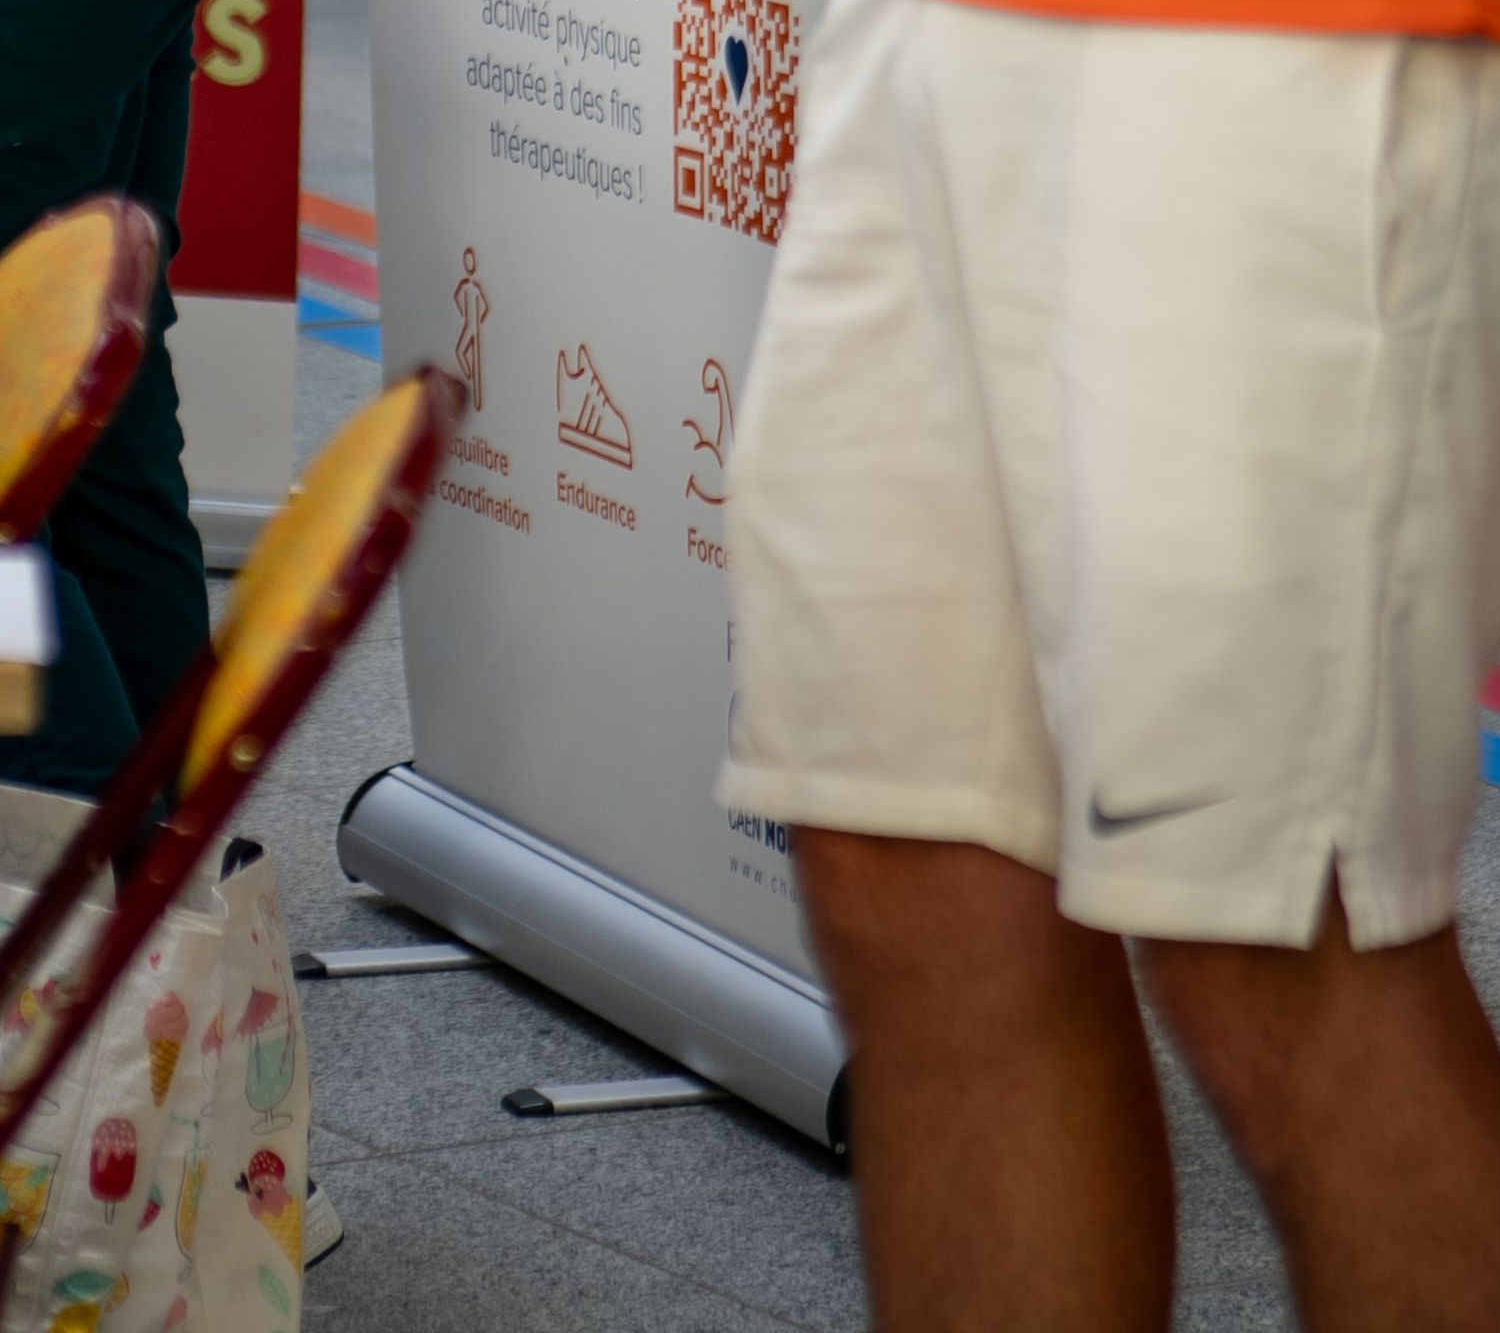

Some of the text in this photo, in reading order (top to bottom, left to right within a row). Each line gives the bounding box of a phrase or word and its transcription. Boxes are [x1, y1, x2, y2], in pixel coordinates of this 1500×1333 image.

[556, 10, 641, 69] physique
[466, 52, 642, 138] adaptée à des fins
[490, 120, 633, 203] thérapeutiques
[446, 432, 509, 477] quilibre
[439, 478, 531, 535] coordination
[556, 471, 637, 532] Endurance
